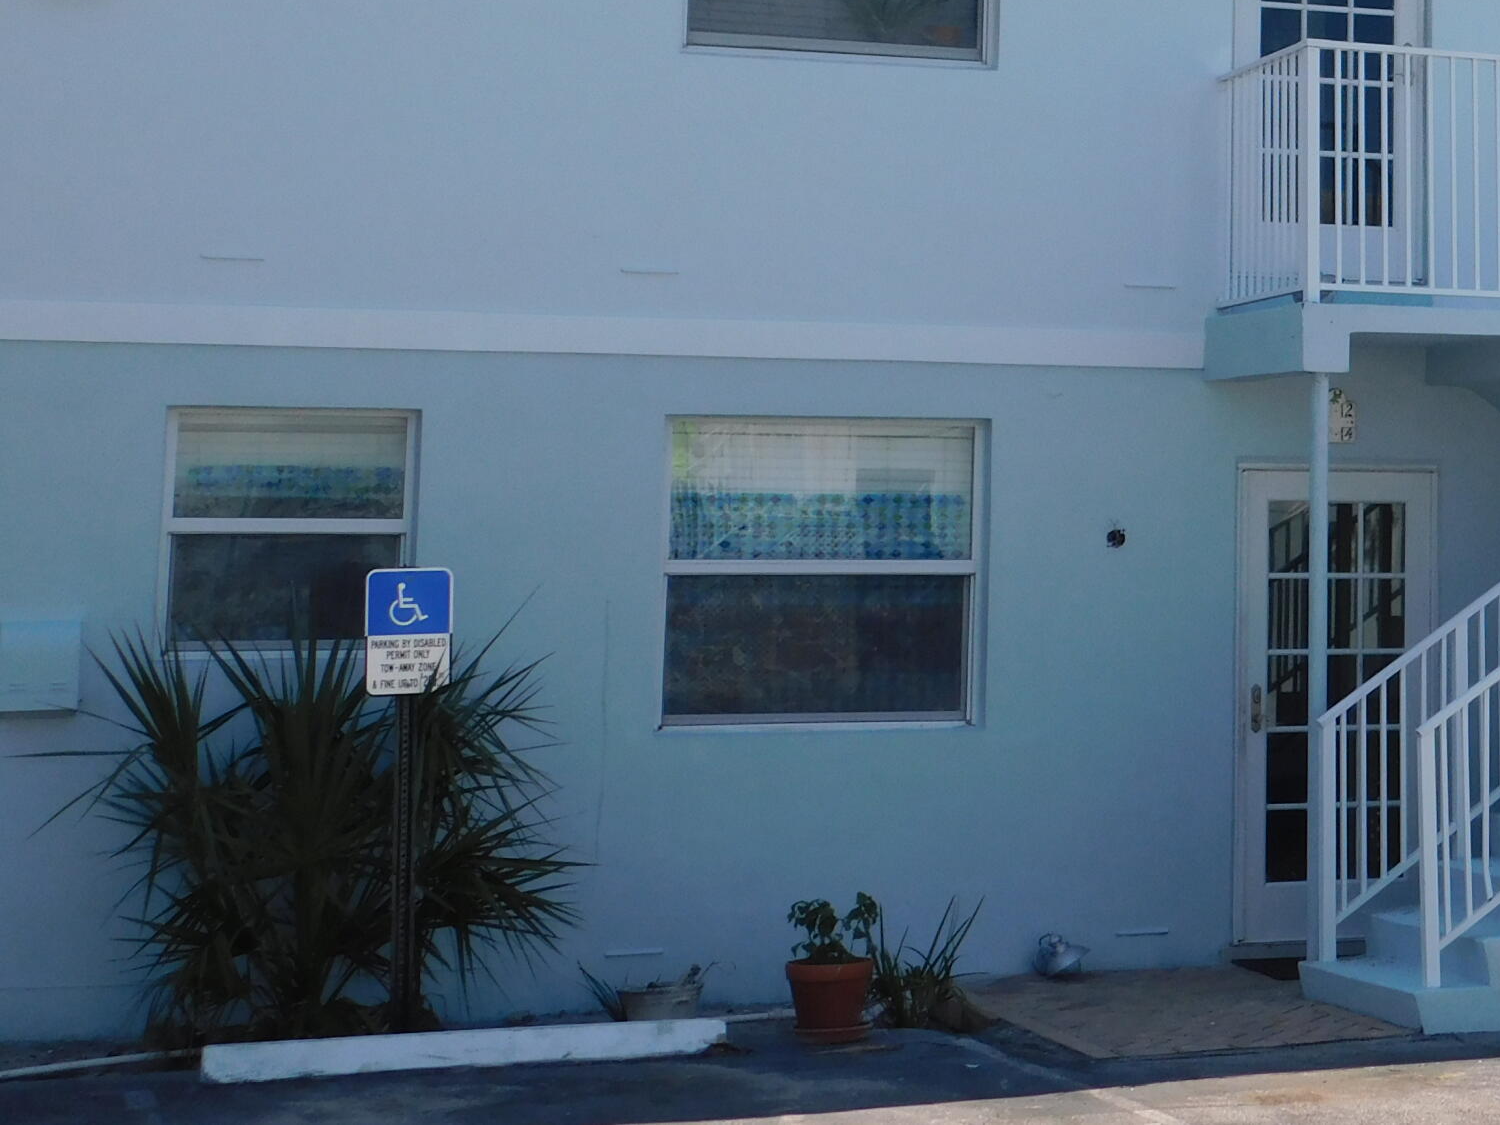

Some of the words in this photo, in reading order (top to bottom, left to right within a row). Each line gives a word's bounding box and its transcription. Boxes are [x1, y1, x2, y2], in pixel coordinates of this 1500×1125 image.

[371, 640, 399, 649] PARKING
[402, 639, 411, 648] BY
[413, 637, 446, 647] DISABLED
[386, 650, 410, 659] PERMIT
[413, 649, 430, 659] ONLY
[418, 661, 436, 671] ZONE
[380, 679, 395, 689] FINE
